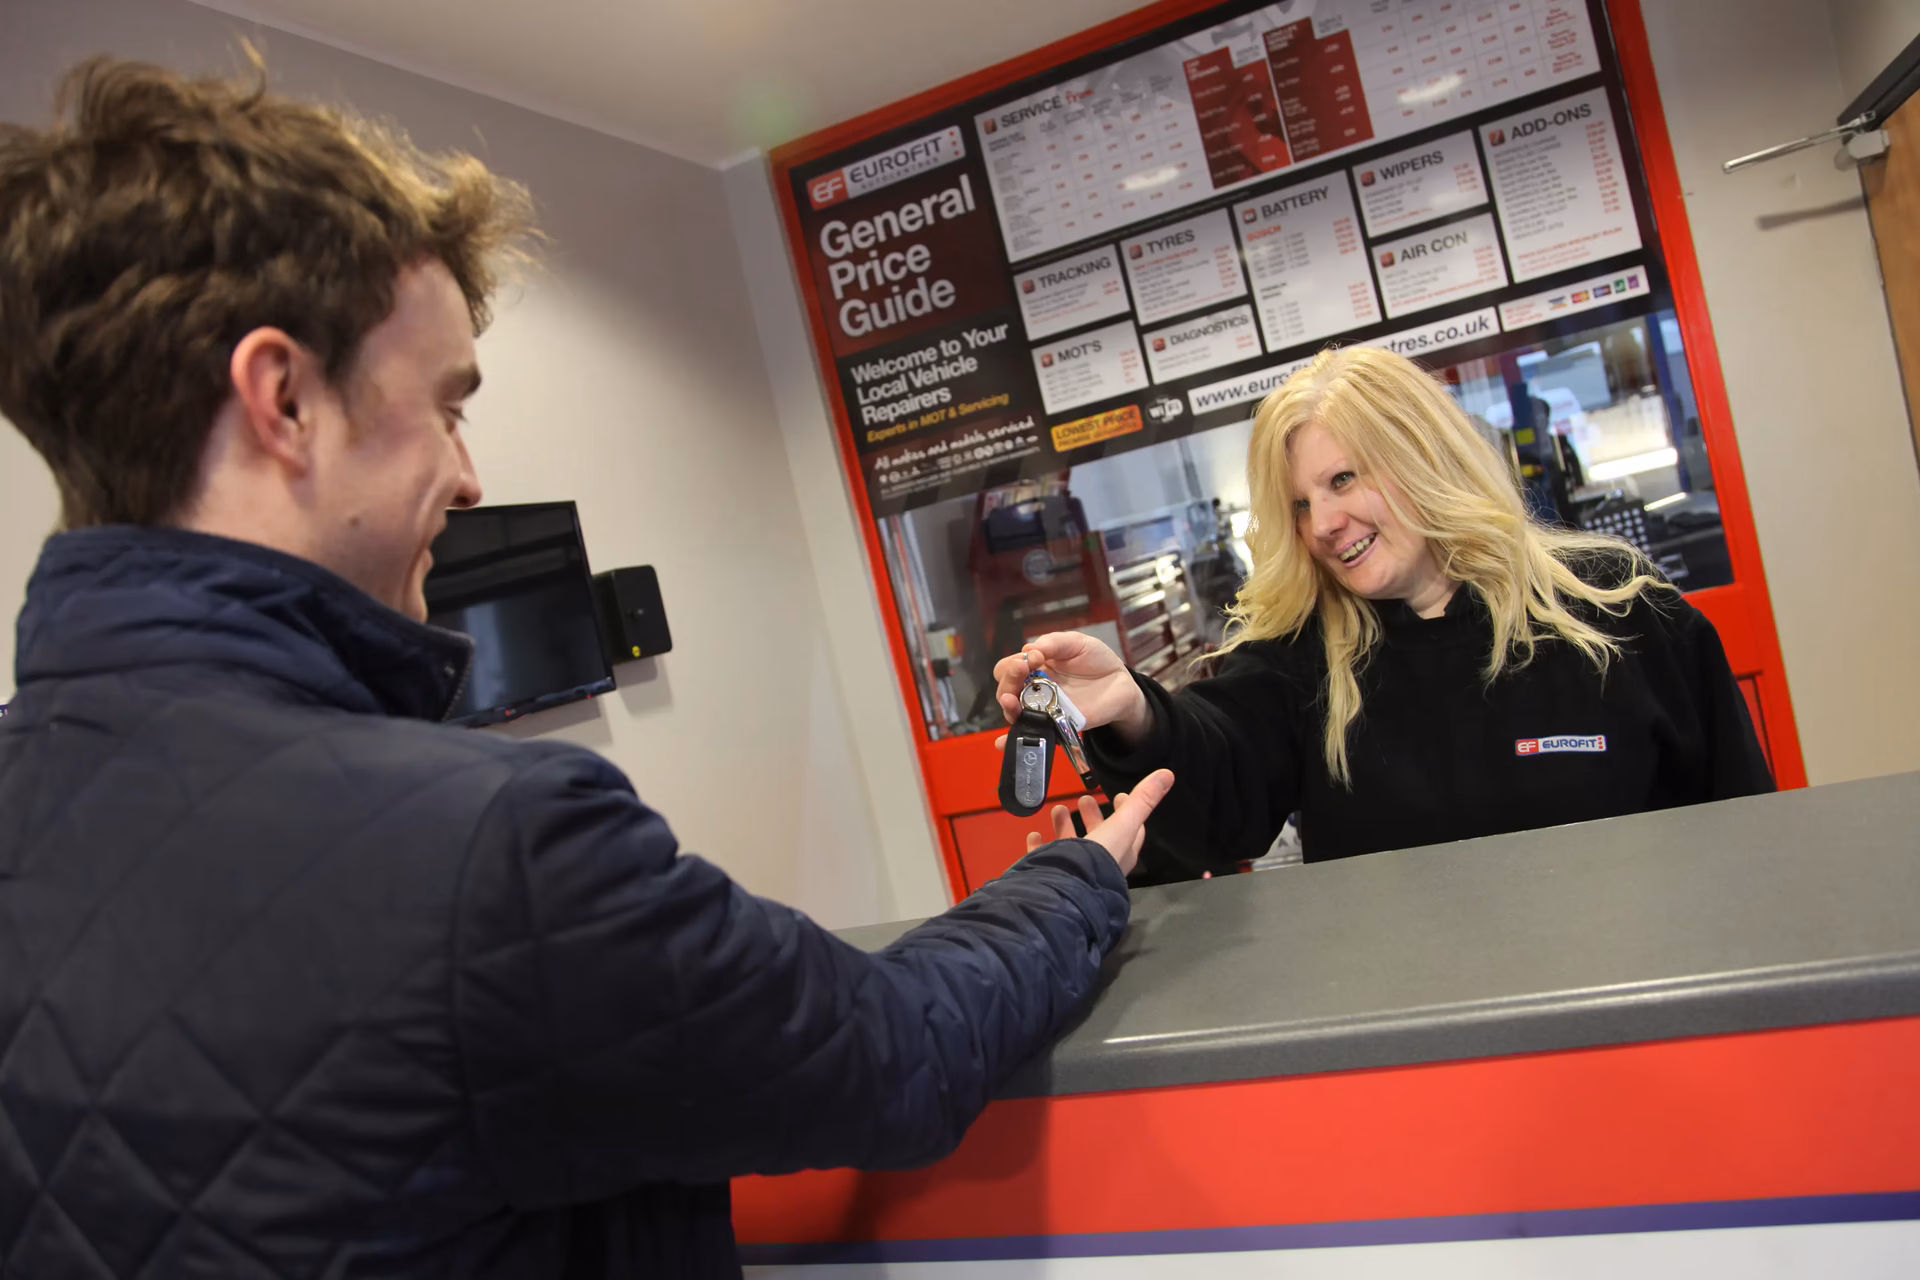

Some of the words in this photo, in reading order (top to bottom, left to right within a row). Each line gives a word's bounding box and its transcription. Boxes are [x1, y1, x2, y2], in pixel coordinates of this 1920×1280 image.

[1000, 96, 1062, 129] SERVICE
[1511, 104, 1592, 140] ADD-ONS
[849, 137, 943, 184] EUROFIT
[1379, 150, 1444, 180] WIPERS
[820, 173, 976, 258] General
[1261, 186, 1329, 218] BATTERY
[1146, 229, 1195, 255] TYRES
[1400, 243, 1428, 263] AIR
[1431, 231, 1468, 252] CON
[827, 243, 931, 300] Price
[1038, 256, 1111, 289] TRACKING
[838, 277, 956, 337] Guide
[1170, 314, 1249, 346] DIAGNOSTICS
[851, 345, 938, 384] Welcome
[940, 339, 961, 357] to
[962, 324, 1009, 348] Your
[1057, 340, 1102, 363] MOT'S
[856, 373, 908, 405] Local
[908, 353, 978, 388] Vehicle
[861, 386, 952, 425] Repairers
[867, 420, 906, 443] Experts
[908, 418, 919, 431] in
[920, 409, 947, 427] MOT
[1055, 418, 1101, 440] LOWEST
[1103, 408, 1136, 427] PRICE
[1542, 738, 1597, 749] EUROFIT
